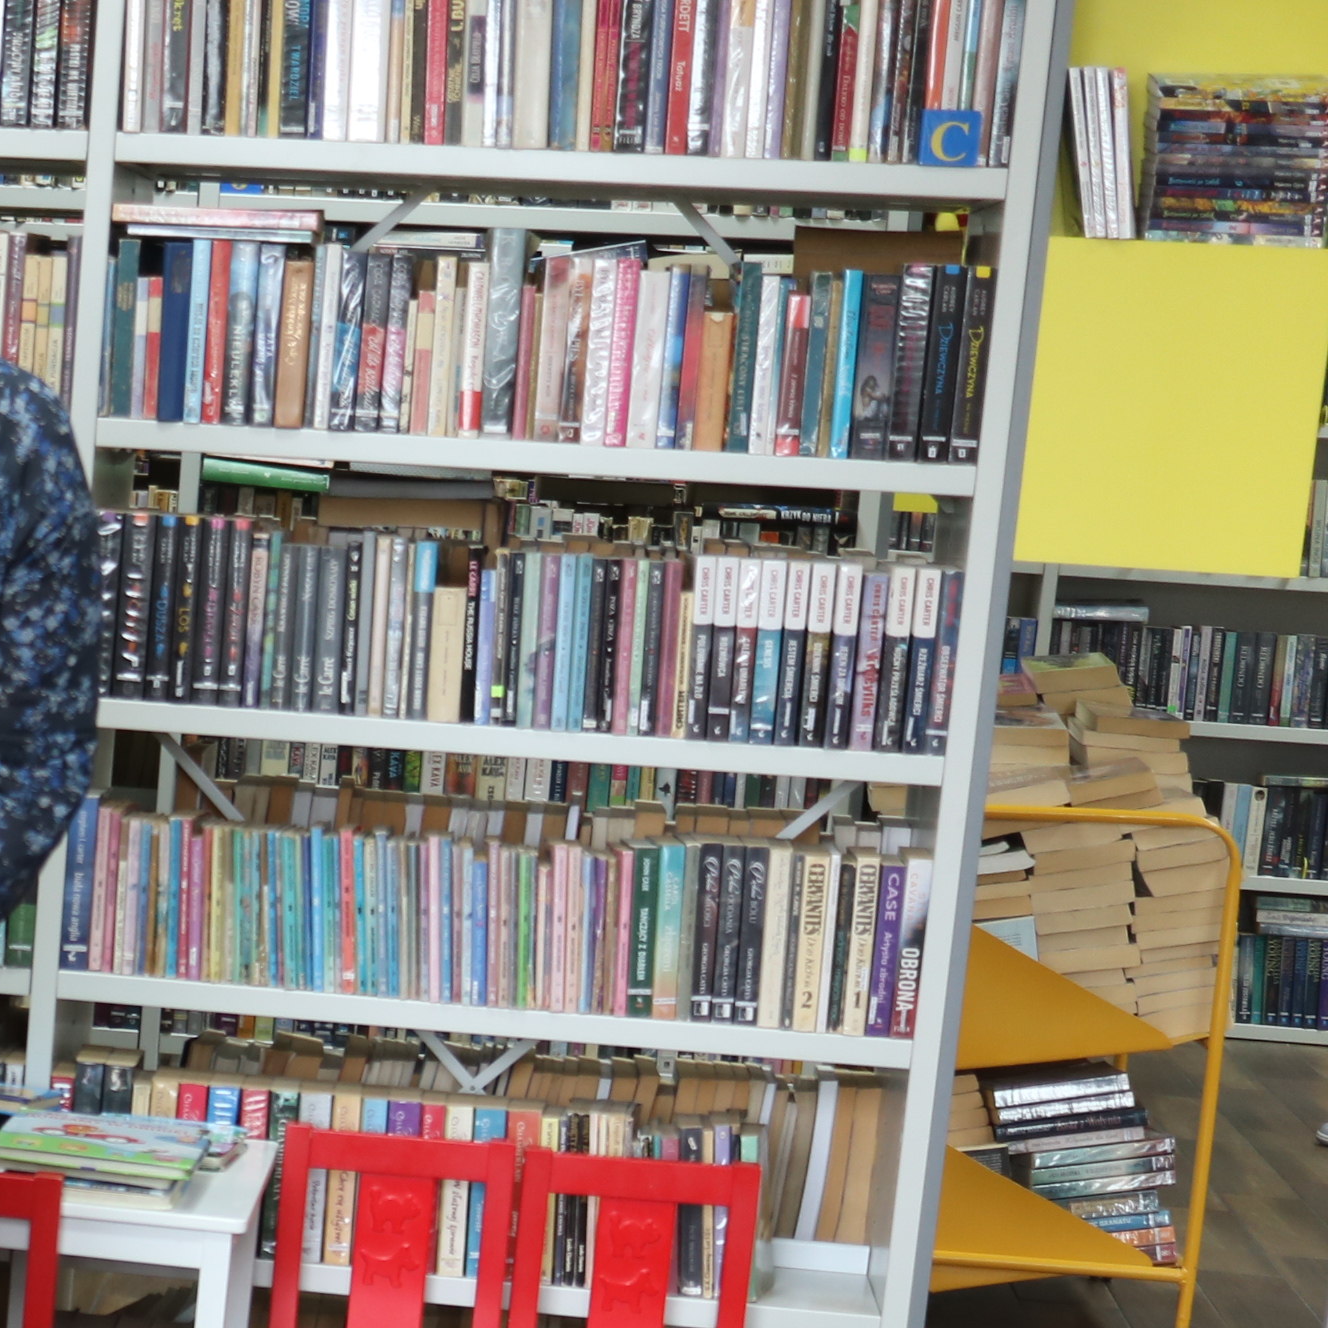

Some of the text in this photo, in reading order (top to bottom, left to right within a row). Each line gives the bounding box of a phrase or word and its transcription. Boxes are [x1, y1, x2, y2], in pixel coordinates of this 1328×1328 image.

[630, 4, 644, 39] BRYNDZA
[289, 45, 302, 100] TWARDZIEL
[930, 121, 970, 162] C
[374, 262, 384, 286] CORA
[972, 289, 980, 317] CARLAN
[49, 338, 59, 378] FUNDACJA
[737, 336, 750, 386] STRACONY
[934, 322, 953, 395] DZIEWCZYNA
[965, 325, 985, 399] DZIEWCZYNA
[780, 509, 802, 521] KRZYK
[802, 511, 811, 522] DO
[812, 511, 832, 523] NIEBA
[252, 556, 265, 594] ROBYN
[700, 567, 710, 616] CHRIS CARTER
[722, 566, 733, 615] CHRIS CARTER
[766, 569, 779, 618] CHRIS CARTER
[791, 569, 804, 618] CHRIS CARTER
[348, 579, 358, 621] Conan wielki
[608, 595, 616, 616] POZA
[817, 575, 828, 623] CHRIS CARTER
[844, 576, 855, 624] CHRIS CARTER
[870, 583, 882, 642] CHRIS CARTER
[897, 577, 908, 625] CHRIS CARTER
[922, 578, 935, 626] CHRIS CARTER
[155, 600, 168, 642] DUSZA
[177, 607, 190, 633] LOS
[463, 601, 476, 670] THE RUSSIA HOUSE
[273, 655, 287, 688] le Carré
[717, 636, 729, 678] ROZMÓWCA
[762, 639, 773, 669] GENESIS
[786, 640, 798, 665] JESTEM
[809, 642, 823, 703] DZIENNIK ŚMIERCI
[295, 655, 311, 694] le Carré
[317, 656, 335, 696] le Carré
[695, 675, 704, 685] NA
[912, 648, 928, 716] RZEŹBIARZ ŚMIERCI
[934, 645, 951, 723] OBSERWATOR ŚMIERCI
[675, 690, 685, 729] CARTER
[430, 766, 442, 788] KAVA
[483, 756, 506, 766] ALEX
[641, 876, 650, 892] CASE
[643, 858, 652, 876] JOHN
[73, 894, 81, 916] nowa
[69, 917, 80, 942] anglia
[637, 907, 649, 944] TAŃCZĄCY
[801, 863, 826, 1009] CERVANTES Don 2
[852, 864, 877, 1009] CERVANTES Don 1
[877, 873, 900, 1004] CASE Artysta zbrodni
[701, 943, 710, 971] GEORGIA
[723, 945, 731, 974] GEORGIA
[744, 900, 758, 1000] BÓLU GEORGIA CATES
[1266, 938, 1275, 977] YOUNG
[1307, 938, 1315, 976] YOUNG
[699, 972, 707, 995] CATES
[720, 975, 728, 996] CATES
[896, 947, 920, 1011] OBRONA
[1098, 1217, 1131, 1227] GRANATU
